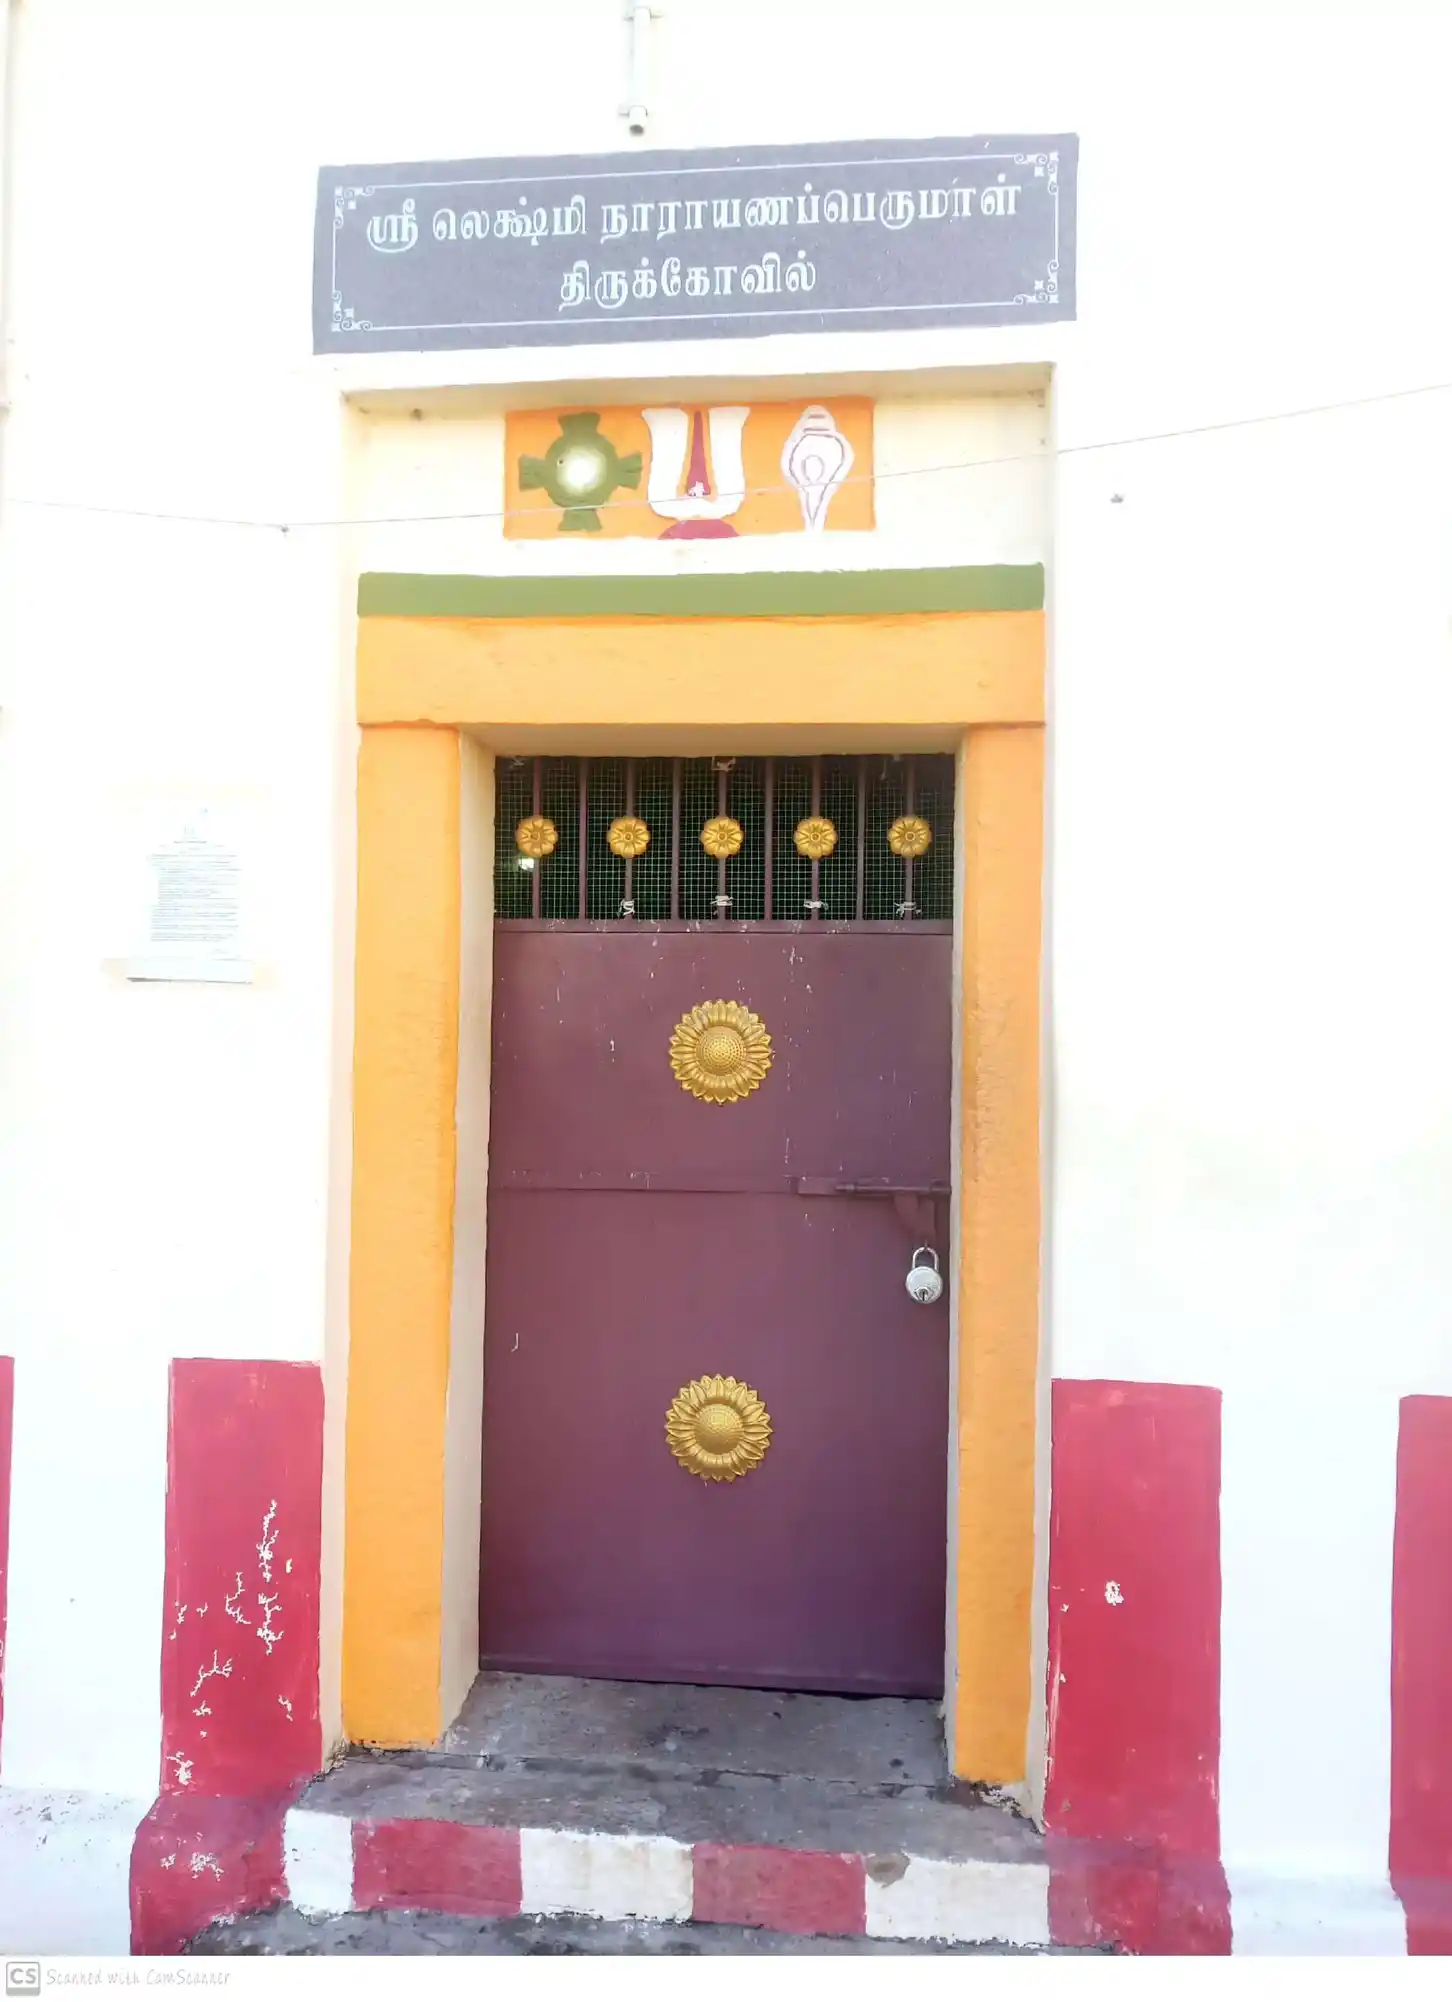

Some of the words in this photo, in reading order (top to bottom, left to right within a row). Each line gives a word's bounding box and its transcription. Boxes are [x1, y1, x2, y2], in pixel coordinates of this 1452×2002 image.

[432, 194, 588, 246] லெக்ஷ்மி
[600, 173, 1022, 244] நாராயணப்பெருமாள்
[558, 249, 817, 313] திருக்கோவில்
